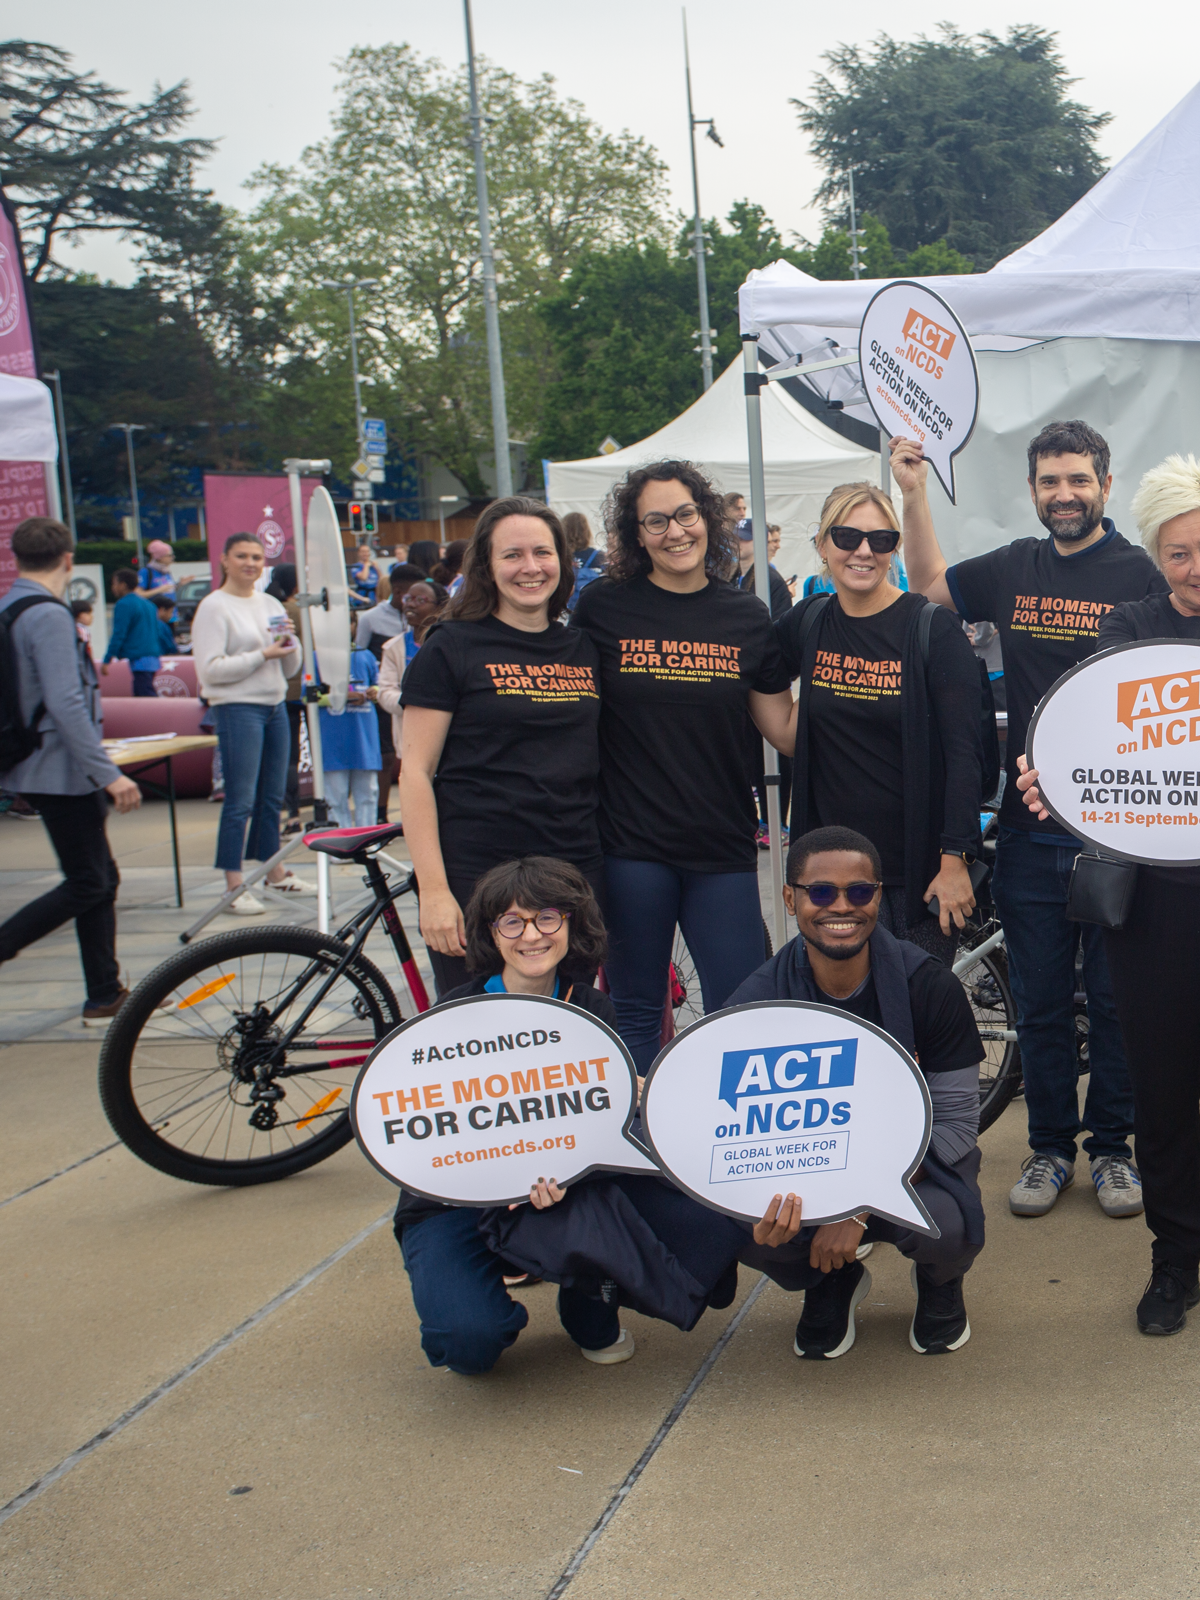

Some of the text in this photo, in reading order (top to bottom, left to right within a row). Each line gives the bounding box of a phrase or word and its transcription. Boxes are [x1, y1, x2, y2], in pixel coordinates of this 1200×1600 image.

[908, 317, 950, 353] ACT
[895, 344, 943, 380] on NCDs
[869, 357, 901, 398] ACTION
[904, 393, 917, 414] ON
[870, 340, 953, 432] GLOBAL WEEK FOR
[876, 384, 926, 442] actonncds.org
[1015, 595, 1115, 615] THE MOMENT
[1012, 610, 1039, 624] FOR
[619, 639, 741, 659] THE MOMENT
[485, 664, 593, 678] THE MOMENT
[621, 653, 740, 672] FOR CARING
[815, 650, 901, 674] THE MOMEN
[812, 680, 830, 688] LOBAL
[813, 665, 843, 682] FOR
[492, 677, 596, 692] FOR CARING
[1117, 741, 1137, 755] on
[1072, 768, 1157, 785] GLOBAL
[1080, 788, 1161, 805] ACTION
[1168, 790, 1197, 806] ON
[1081, 811, 1119, 824] 14-21
[346, 965, 365, 979] ALL
[363, 977, 394, 1024] TERRAINS
[412, 1029, 562, 1065] #ActOnNCDs
[735, 1046, 842, 1093] ACT
[372, 1057, 610, 1116] THE MOMENT
[384, 1086, 611, 1144] FOR CARING
[715, 1098, 851, 1138] on NCDs
[432, 1134, 576, 1168] actonncds.org
[724, 1140, 837, 1161] GLOBAL WEEK FOR
[727, 1156, 830, 1175] ACTION ON NCDs
